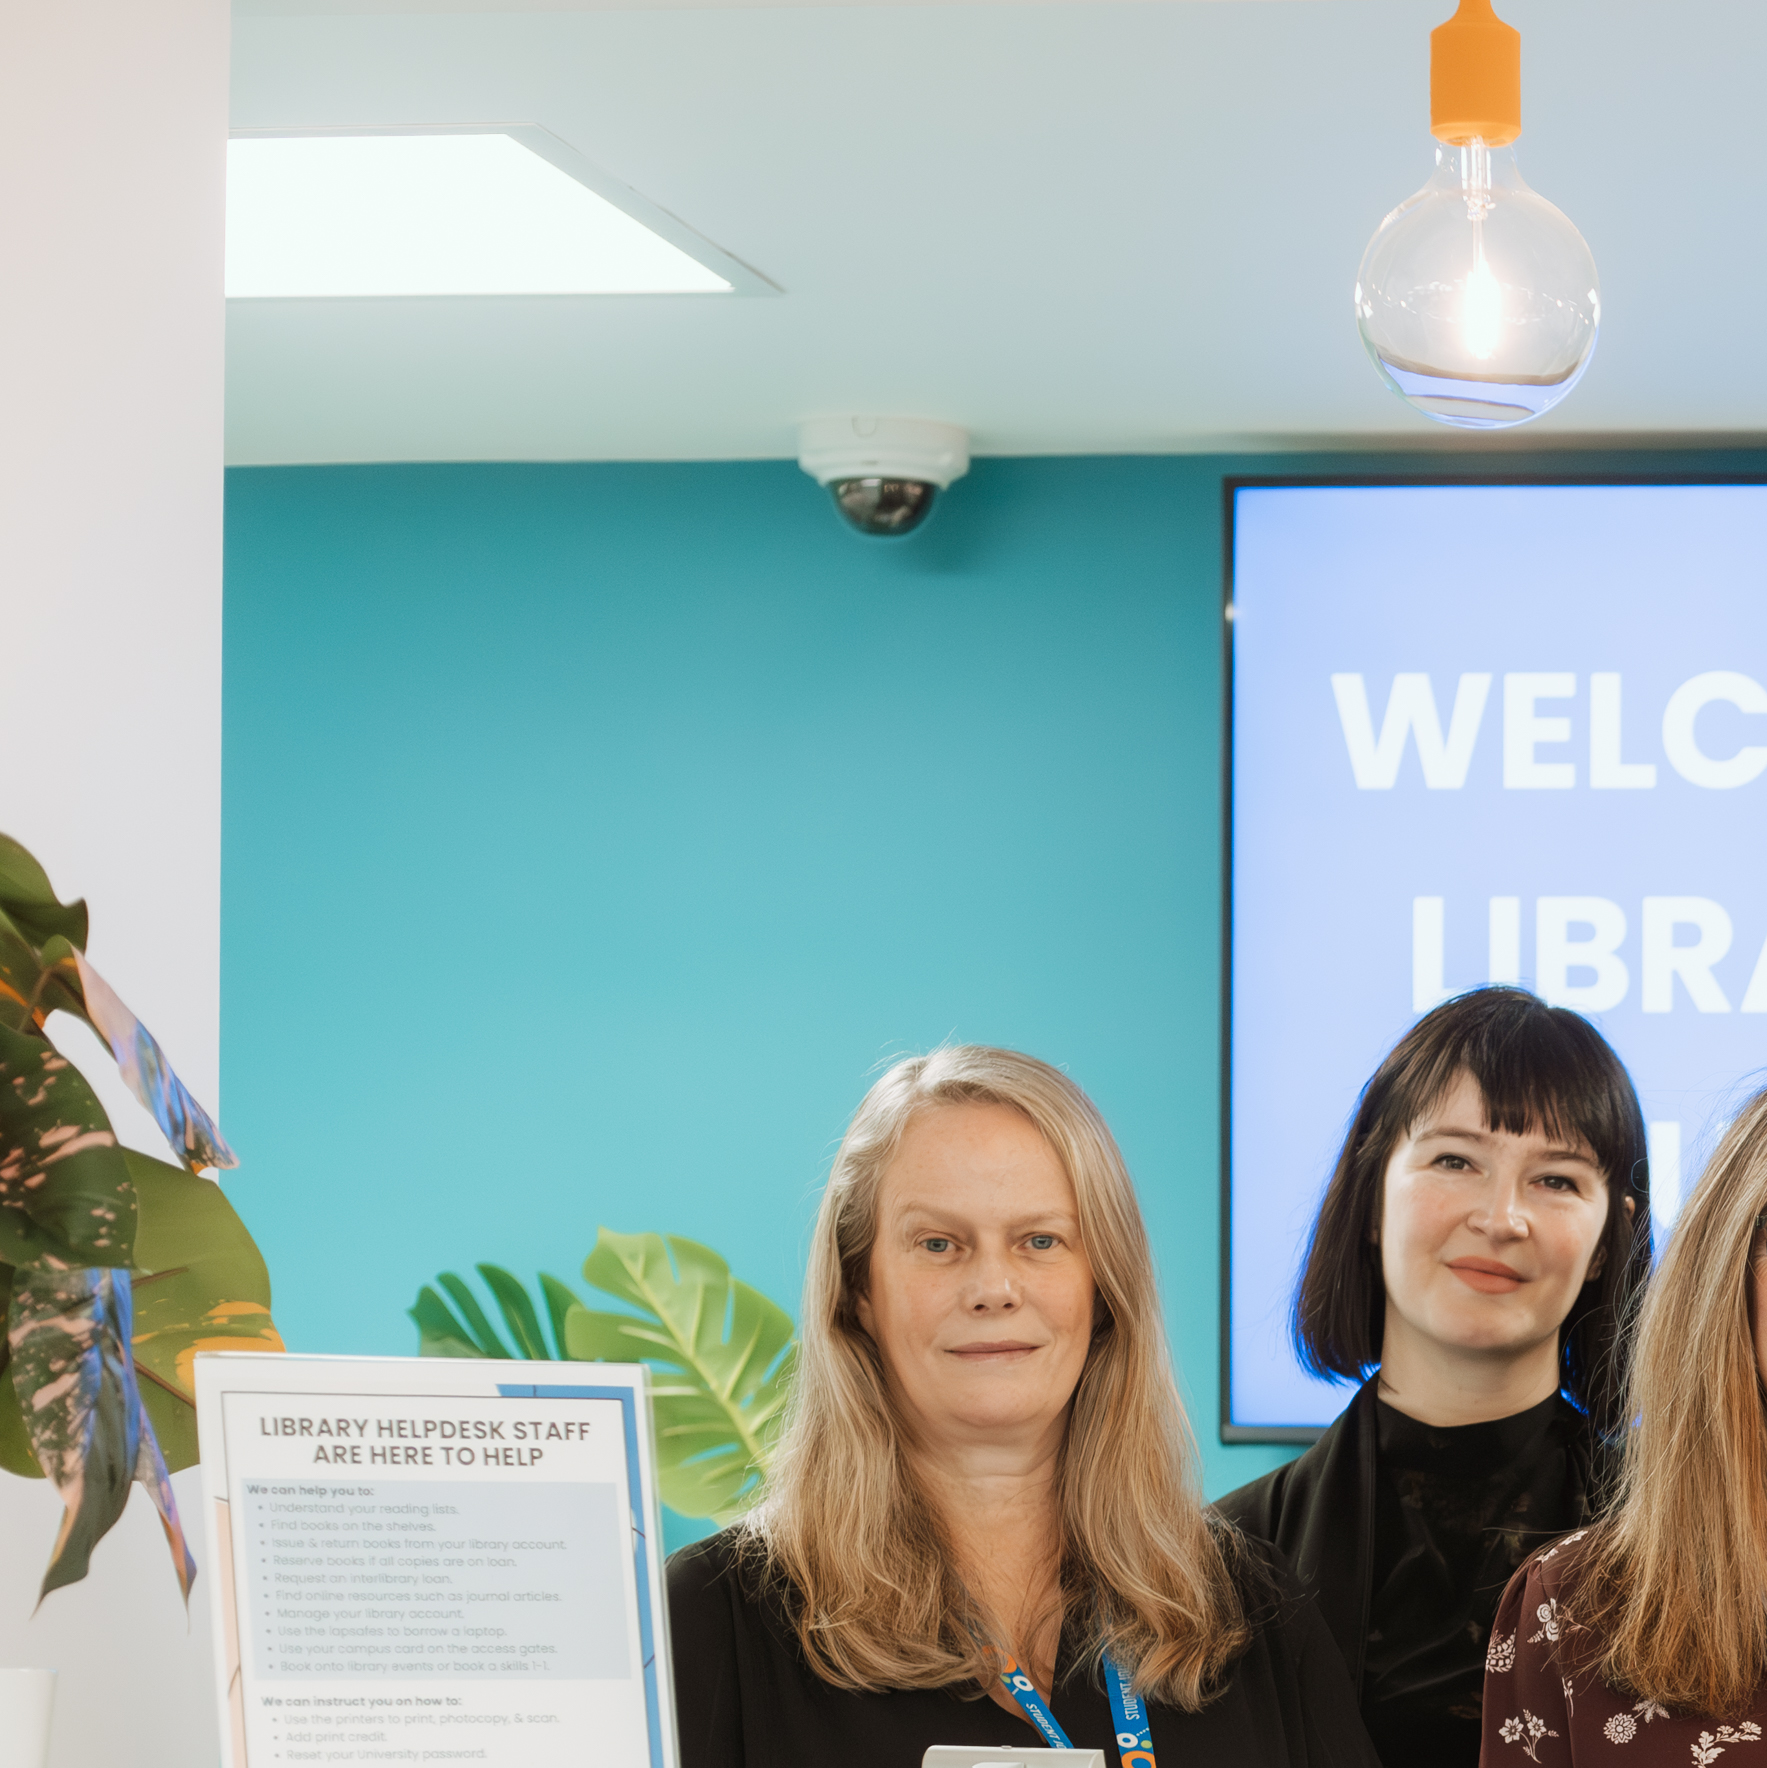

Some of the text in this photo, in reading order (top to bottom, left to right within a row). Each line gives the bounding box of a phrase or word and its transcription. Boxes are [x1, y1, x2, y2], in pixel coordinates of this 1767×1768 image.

[261, 1416, 590, 1442] LIBRARY HELPDESK STAFF
[314, 1444, 543, 1467] ARE HERE TO HELP
[247, 1485, 374, 1499] We can help you to:
[270, 1502, 459, 1518] Understand your reading lists.
[277, 1608, 464, 1622] Manage your library account.
[279, 1643, 303, 1654] Use
[306, 1644, 334, 1656] your
[338, 1644, 391, 1656] campus
[395, 1643, 424, 1654] card
[447, 1644, 468, 1654] the
[471, 1645, 516, 1654] access
[519, 1644, 557, 1658] gates.
[261, 1695, 461, 1709] We can instruct you on how to:
[1119, 1681, 1140, 1721] STUDENT
[1026, 1703, 1060, 1743] STUDENT
[286, 1730, 387, 1745] Add print credit.
[287, 1748, 487, 1762] Reset your University password.
